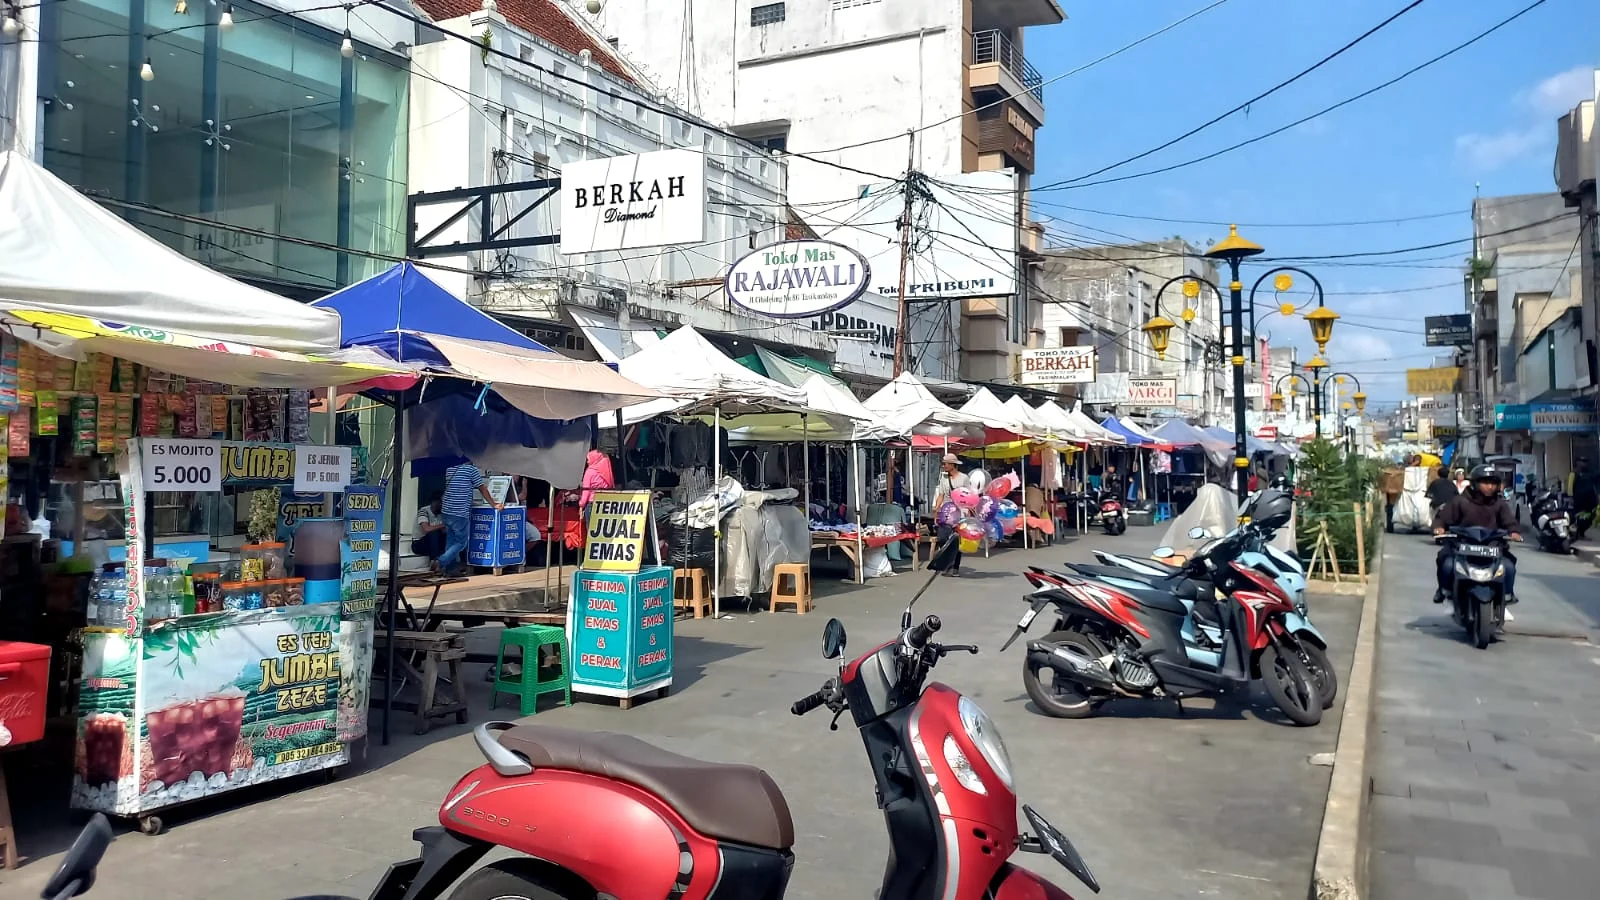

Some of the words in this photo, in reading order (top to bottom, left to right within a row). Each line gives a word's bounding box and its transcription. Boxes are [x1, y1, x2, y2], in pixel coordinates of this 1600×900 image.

[575, 176, 685, 208] BERKAH
[604, 205, 657, 223] Diamond
[763, 251, 798, 266] Toko
[804, 248, 836, 263] Mas
[734, 264, 856, 292] RAJAWALI
[909, 278, 994, 294] PRIBUMI
[1025, 355, 1091, 371] BERKAH
[151, 444, 165, 455] ES
[168, 444, 214, 456] MOJITO
[307, 453, 317, 465] ES
[317, 453, 341, 466] JERUK
[154, 465, 212, 484] 5.000
[347, 494, 380, 510] SEDIA
[594, 500, 644, 516] TERIMA
[590, 518, 641, 539] JUAL
[589, 543, 636, 562] EMAS
[582, 580, 627, 594] TERIMA
[638, 577, 669, 593] TERIMA
[588, 598, 617, 612] JUAL
[585, 618, 619, 631] EMAS
[641, 613, 665, 630] EMAS
[277, 634, 298, 653] ES
[302, 631, 332, 650] TEH
[597, 637, 605, 648] &
[649, 634, 656, 646] &
[581, 654, 621, 668] PERAK
[638, 649, 667, 668] PERAK
[277, 683, 327, 712] ZEZE
